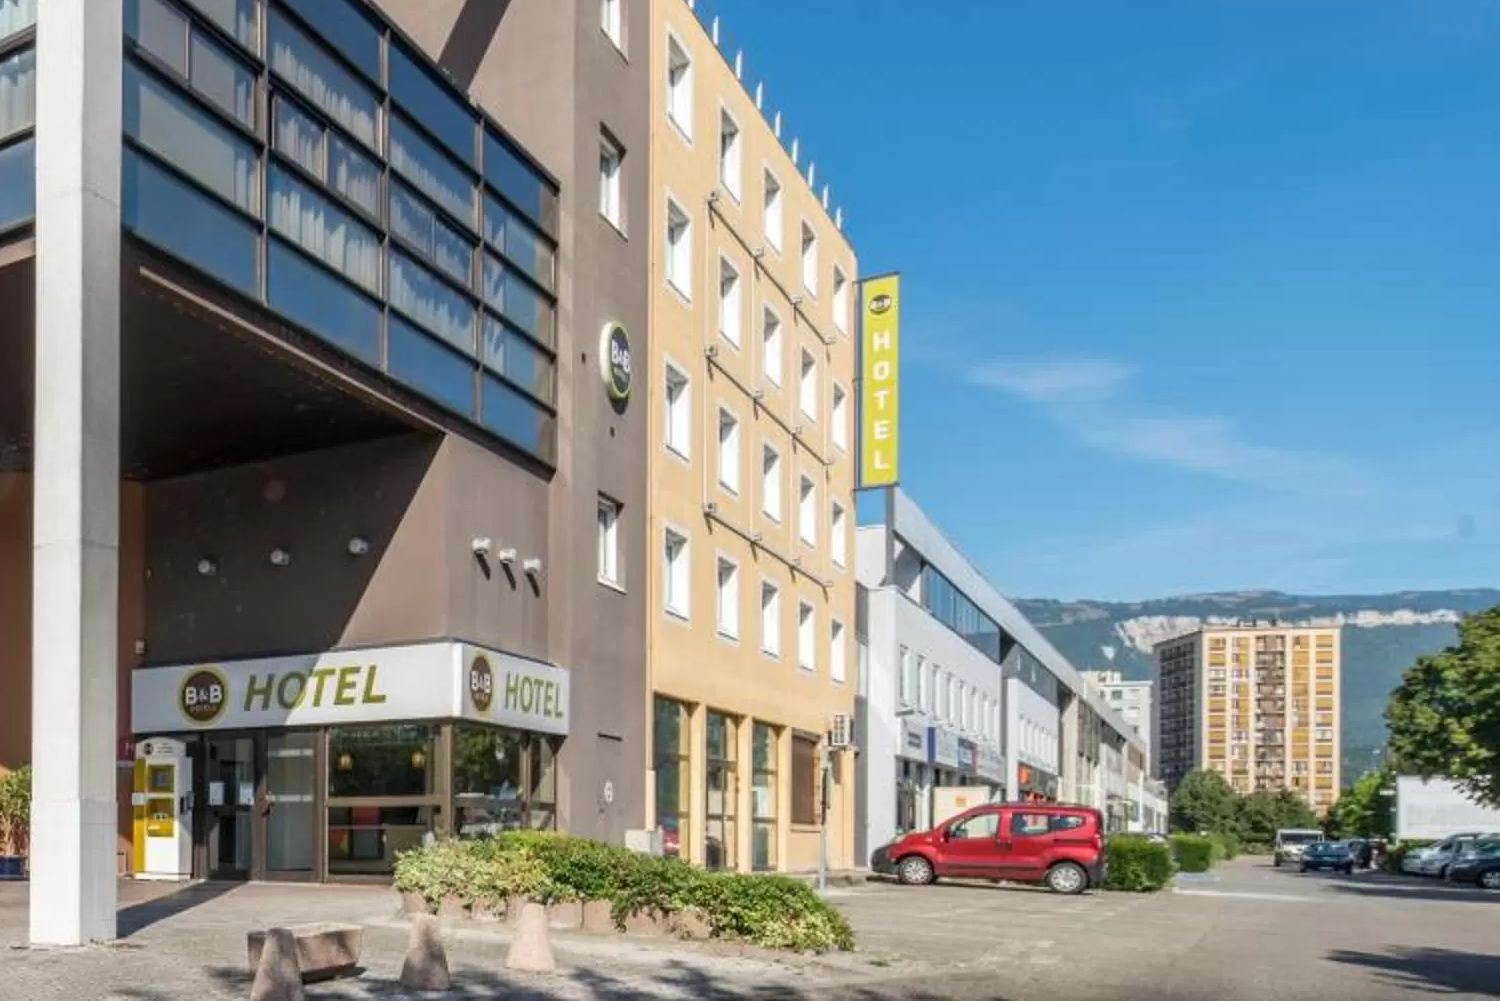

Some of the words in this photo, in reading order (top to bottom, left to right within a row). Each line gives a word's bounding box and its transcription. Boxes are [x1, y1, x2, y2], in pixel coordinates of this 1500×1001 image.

[611, 338, 631, 374] B&B
[872, 330, 891, 471] HOTEL
[185, 684, 222, 705] B&B
[244, 665, 387, 712] HOTEL
[470, 670, 491, 695] B&B
[504, 671, 564, 719] HOTEL
